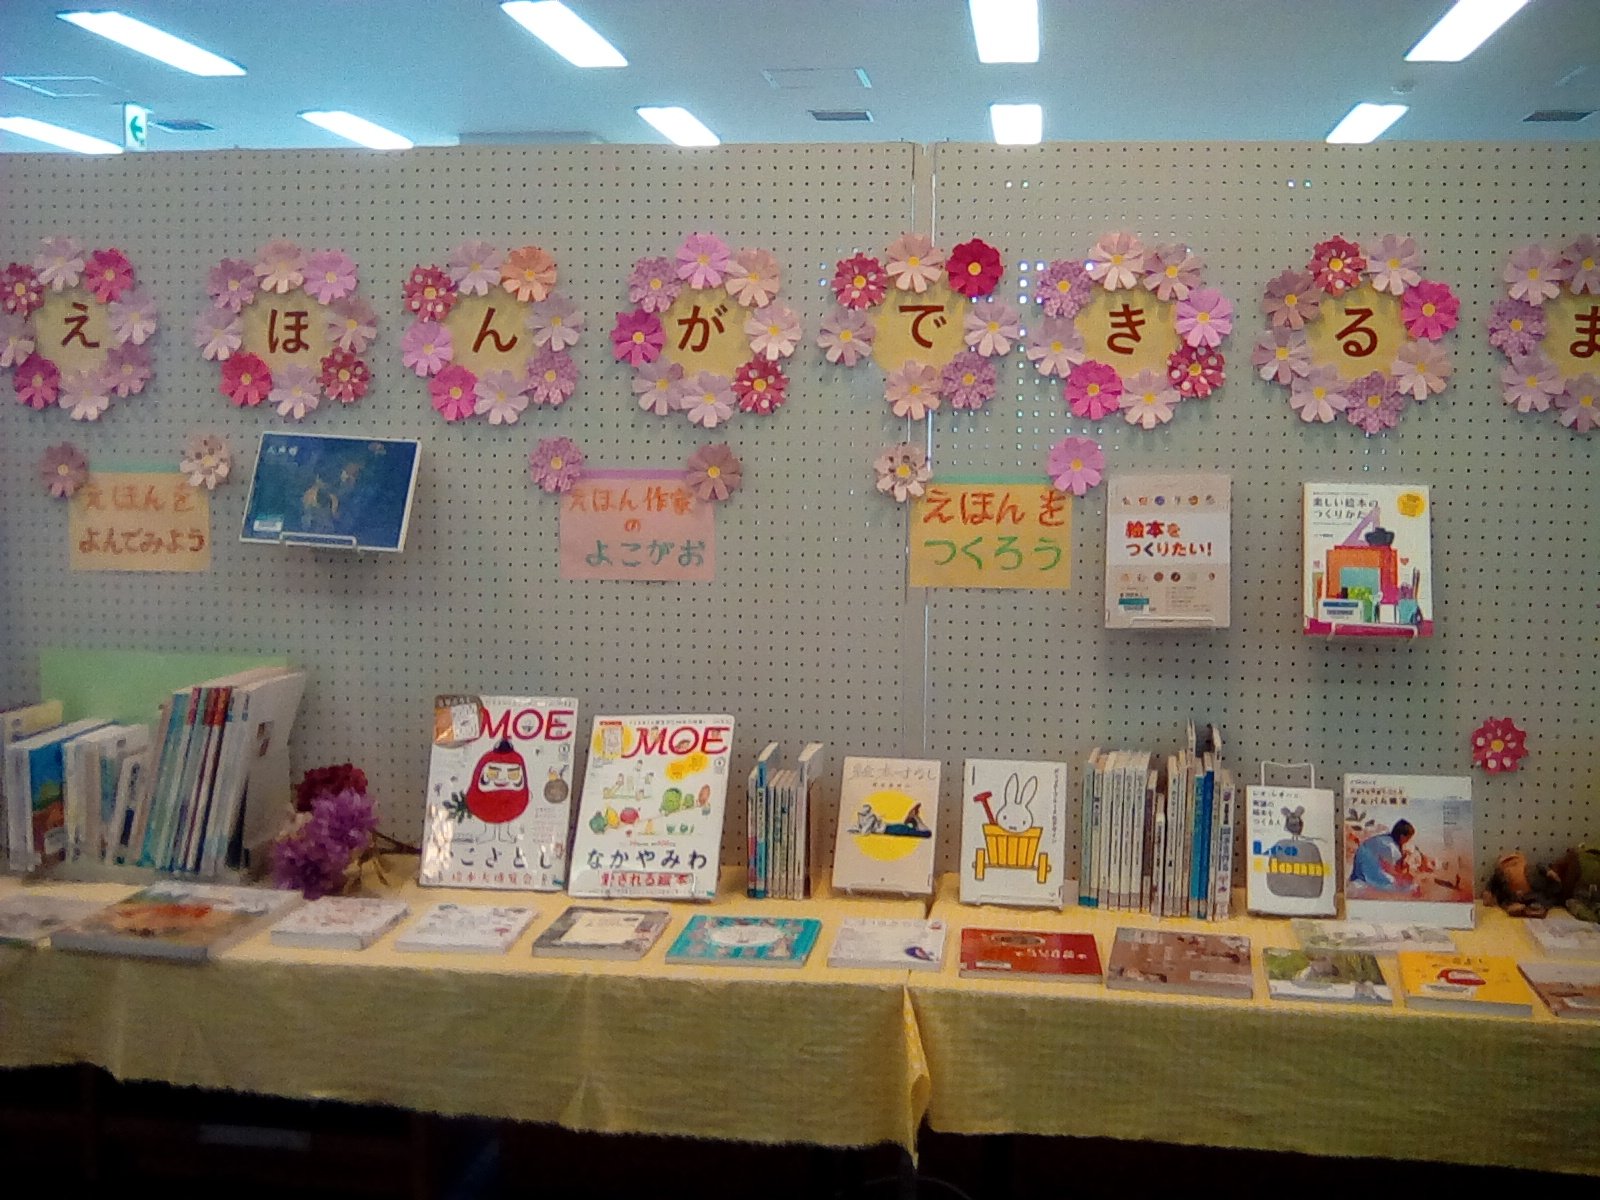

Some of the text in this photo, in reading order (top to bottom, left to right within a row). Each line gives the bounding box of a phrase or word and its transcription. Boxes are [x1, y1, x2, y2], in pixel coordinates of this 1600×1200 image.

[85, 483, 196, 513] えほんを
[569, 486, 694, 515] えほん作家
[923, 489, 1066, 526] えほんを
[623, 518, 641, 532] の
[1125, 520, 1180, 538] 絵本を
[78, 527, 205, 554] よんでみよう
[585, 539, 706, 567] よこがお
[924, 536, 1062, 571] つくろう
[480, 707, 574, 741] MOE
[621, 726, 730, 758] MOE
[436, 846, 552, 869] こさとし
[586, 849, 708, 869] なかやみわ
